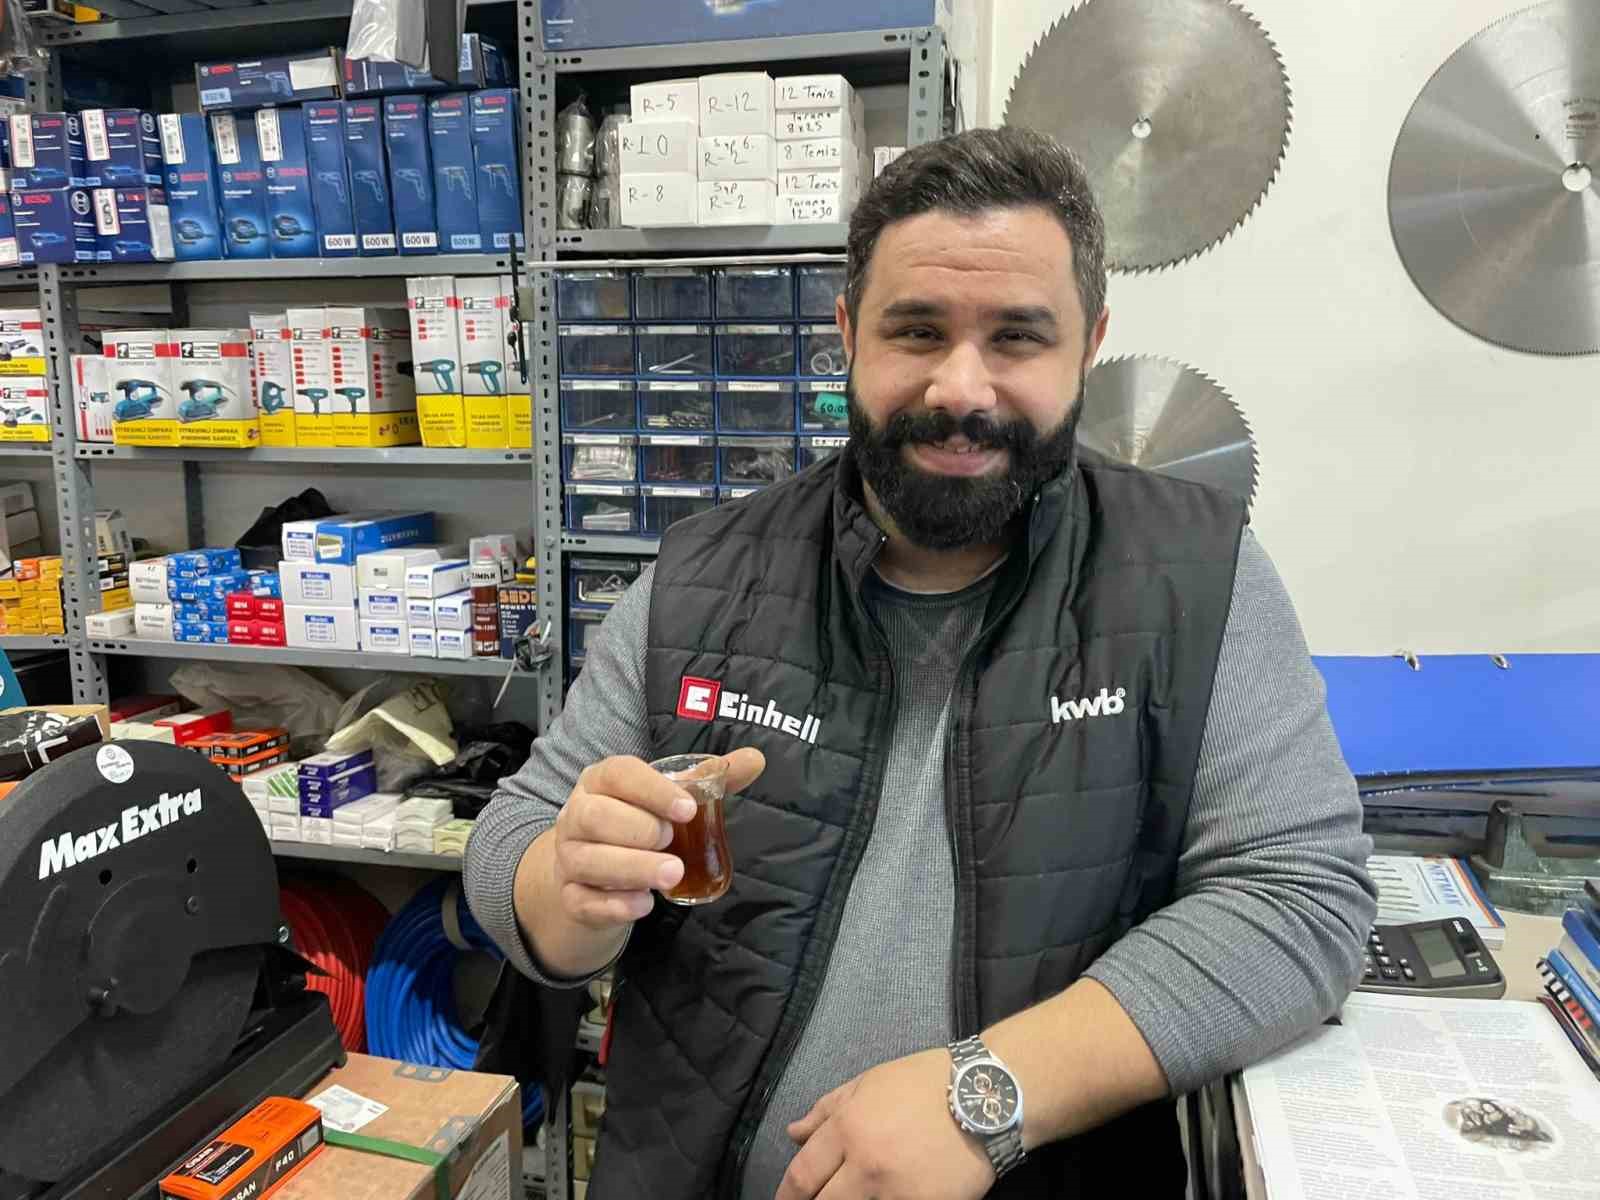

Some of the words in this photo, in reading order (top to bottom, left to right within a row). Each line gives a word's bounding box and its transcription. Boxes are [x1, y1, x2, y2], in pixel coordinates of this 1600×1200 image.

[708, 91, 759, 113] R-12
[782, 86, 800, 100] 12
[783, 144, 793, 160] 8
[785, 175, 801, 189] 12
[719, 690, 820, 744] Einhell
[38, 822, 121, 880] Max
[121, 788, 203, 844] Extra
